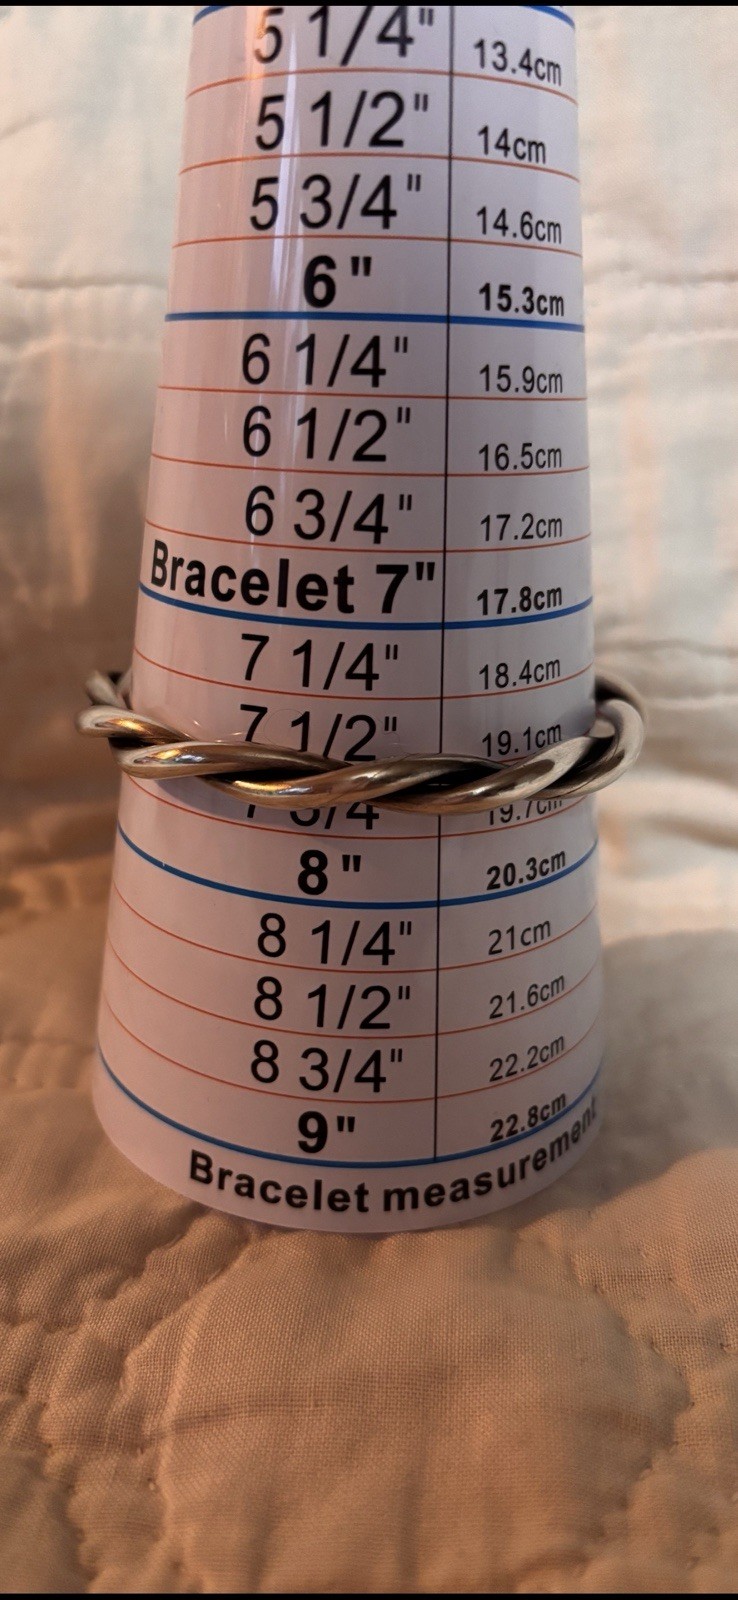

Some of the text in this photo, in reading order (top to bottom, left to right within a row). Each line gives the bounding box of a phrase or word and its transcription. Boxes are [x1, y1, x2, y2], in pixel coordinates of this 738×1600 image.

[257, 6, 284, 64] 5
[474, 39, 562, 87] 13.4cm
[256, 90, 428, 151] 5 1/2"
[477, 126, 546, 164] 14cm
[250, 174, 421, 231] 5 3/4"
[476, 206, 562, 244] 14.6cm
[478, 283, 565, 316] 15.3cm
[243, 333, 408, 387] 6 1/4"
[480, 364, 562, 393] 15.9cm
[243, 406, 410, 462] 6 1/2"
[479, 443, 561, 471] 16.5cm
[246, 485, 412, 544] 6 3/4"
[481, 513, 562, 541] 17.2cm
[150, 539, 435, 613] Bracelet 7"
[477, 586, 562, 615] 17.8cm
[242, 634, 398, 691] 7 1/4"
[479, 659, 561, 689] 18.4cm
[240, 704, 397, 761] 7 1/2"
[482, 724, 562, 757] 19.1cm
[487, 849, 567, 890] 20.3cm
[258, 913, 411, 965] 8 1/4"
[488, 921, 550, 955] 21cm
[254, 976, 410, 1029] 8 1/2"
[489, 976, 564, 1019] 21.6cm
[251, 1040, 402, 1093] 8 3/4"
[489, 1036, 564, 1082] 22.2cm
[490, 1093, 568, 1142] 22.8cm
[189, 1096, 597, 1212] Bracelet measurement
